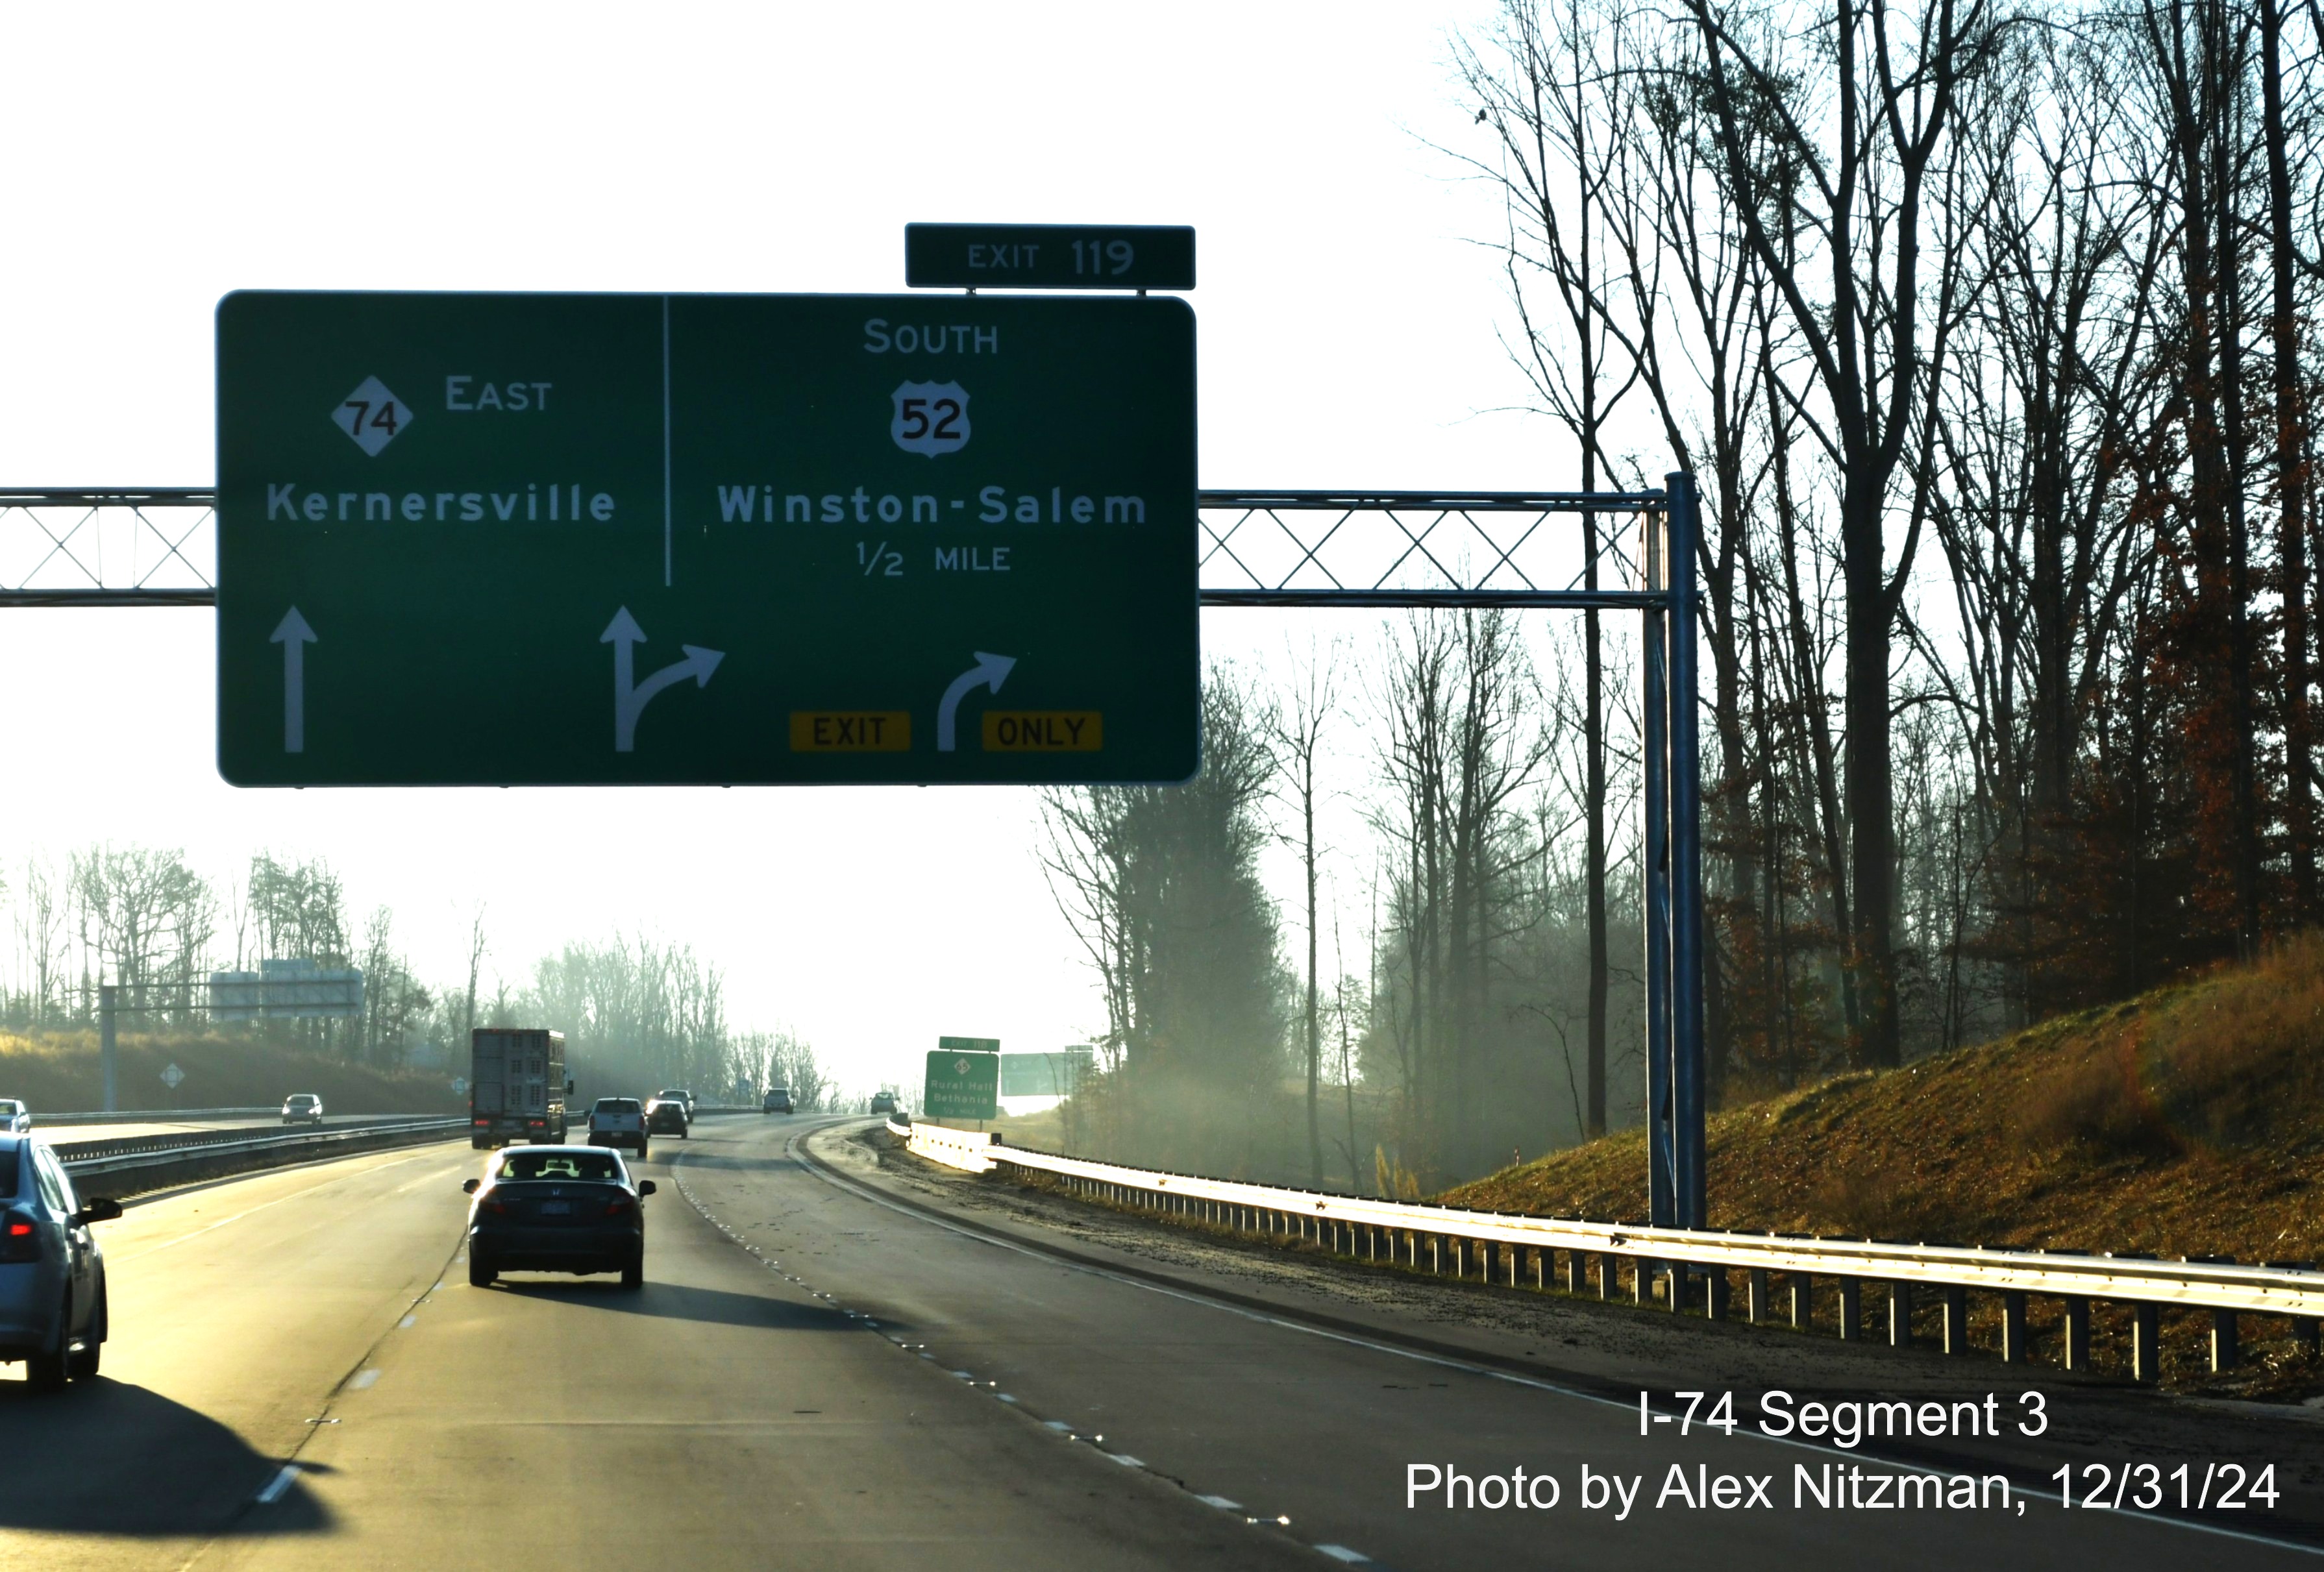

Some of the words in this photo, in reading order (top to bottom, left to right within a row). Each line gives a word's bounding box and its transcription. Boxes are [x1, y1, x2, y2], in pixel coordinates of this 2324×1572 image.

[969, 245, 1039, 269] EXIT
[1072, 240, 1134, 275] 119
[863, 319, 998, 354] SOUTH
[345, 400, 398, 436] 74
[446, 375, 552, 411] EAST
[902, 399, 961, 440] 52
[267, 483, 615, 523] Kernersville
[717, 485, 1146, 524] Winston-Salem
[856, 541, 904, 576] 1/2
[935, 547, 1011, 572] MILE
[814, 717, 886, 746] EXIT
[998, 717, 1086, 746] ONLY
[931, 1080, 963, 1090] Rural
[969, 1081, 993, 1091] Hall
[933, 1093, 987, 1104] Bethania
